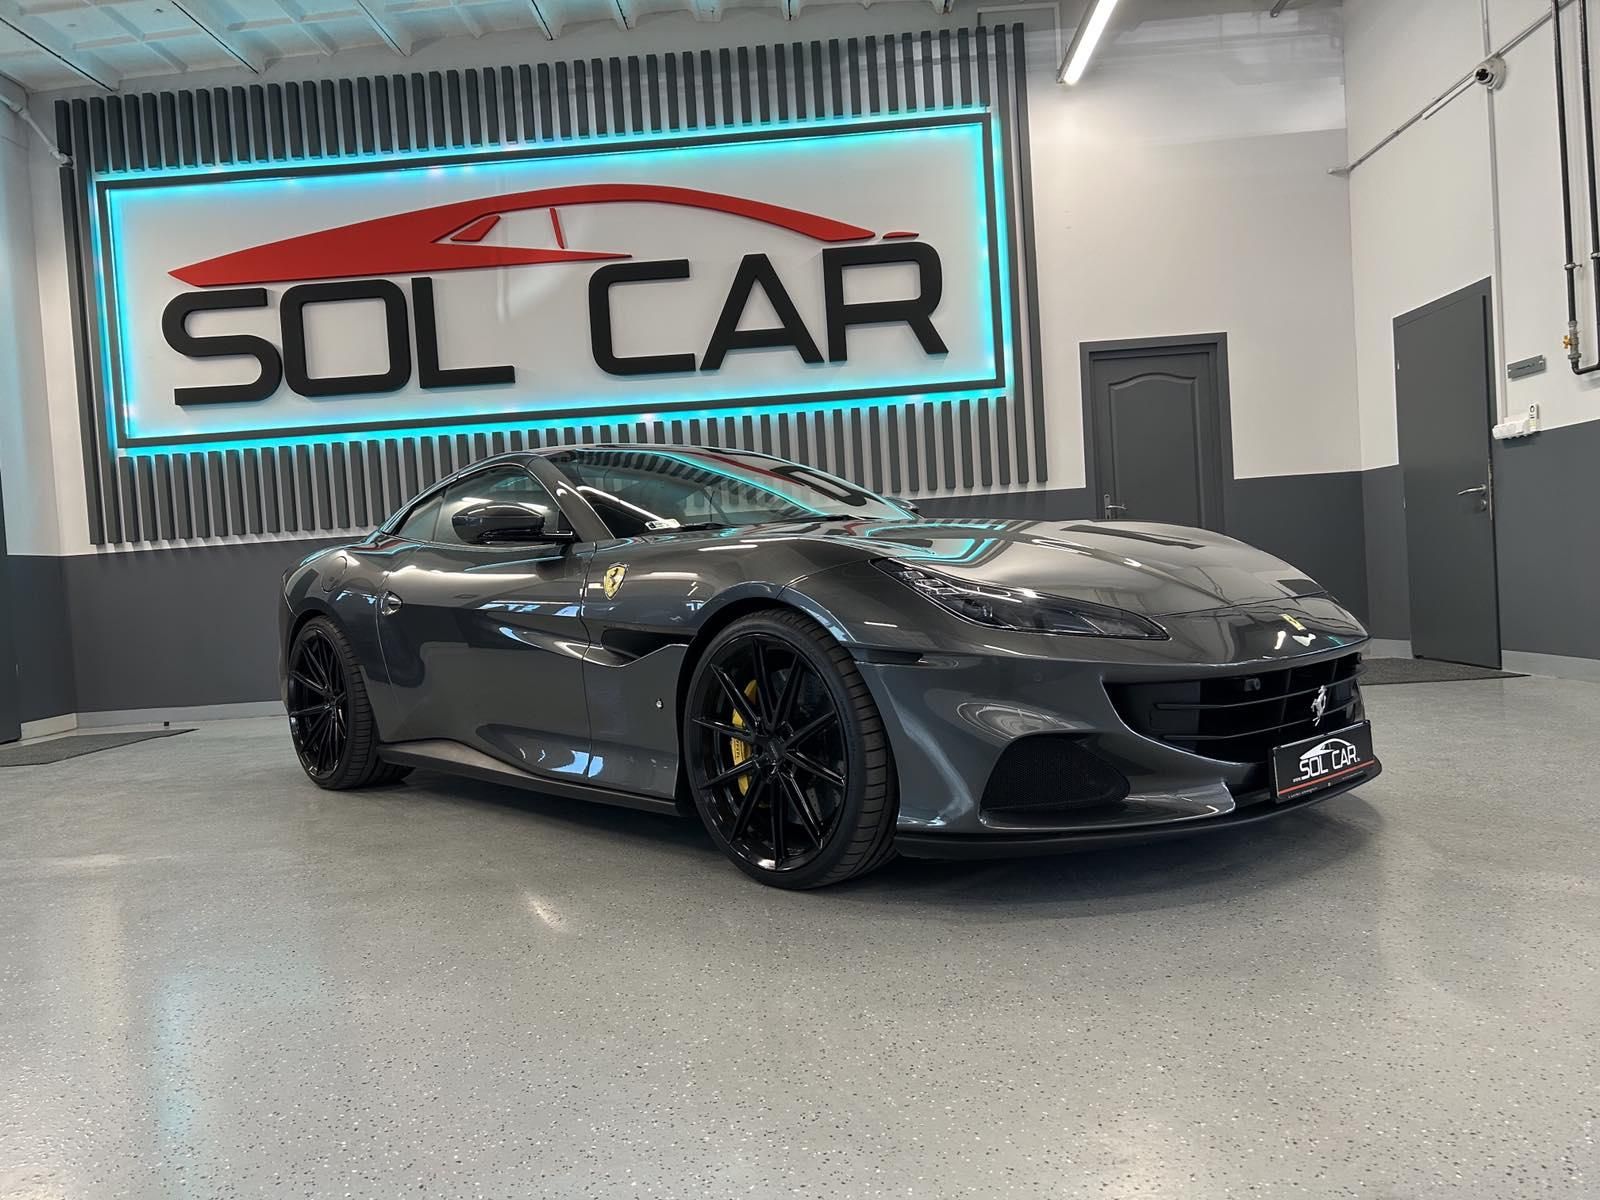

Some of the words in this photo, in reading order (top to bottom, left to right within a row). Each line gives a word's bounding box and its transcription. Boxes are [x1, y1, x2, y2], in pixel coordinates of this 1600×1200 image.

[161, 276, 515, 406] SOL
[588, 241, 949, 376] CAR
[1299, 755, 1329, 781] SOL
[1331, 745, 1358, 770] CAR
